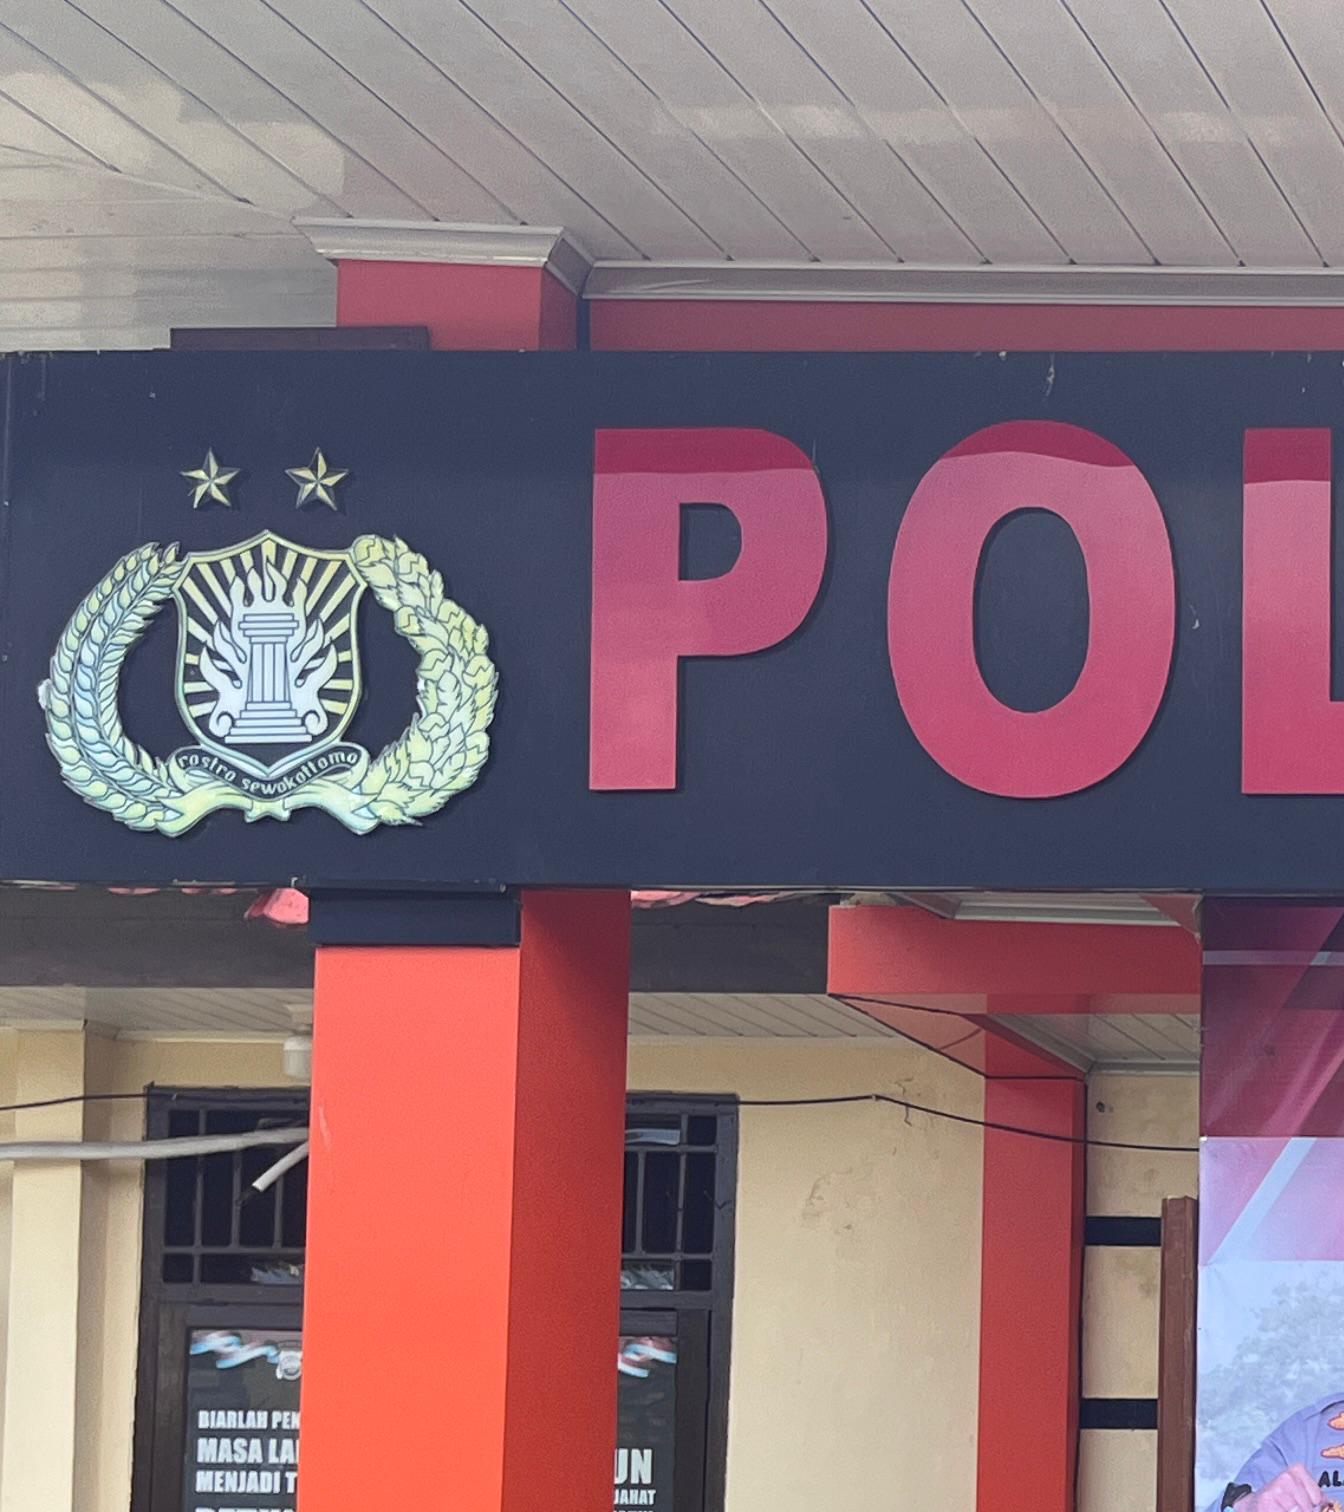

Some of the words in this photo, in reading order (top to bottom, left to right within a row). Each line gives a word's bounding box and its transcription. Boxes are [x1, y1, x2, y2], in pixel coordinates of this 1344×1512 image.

[198, 1410, 268, 1429] BIARLAH
[197, 1437, 263, 1464] MASA
[268, 1437, 300, 1464] LA
[195, 1470, 281, 1494] MENJADI
